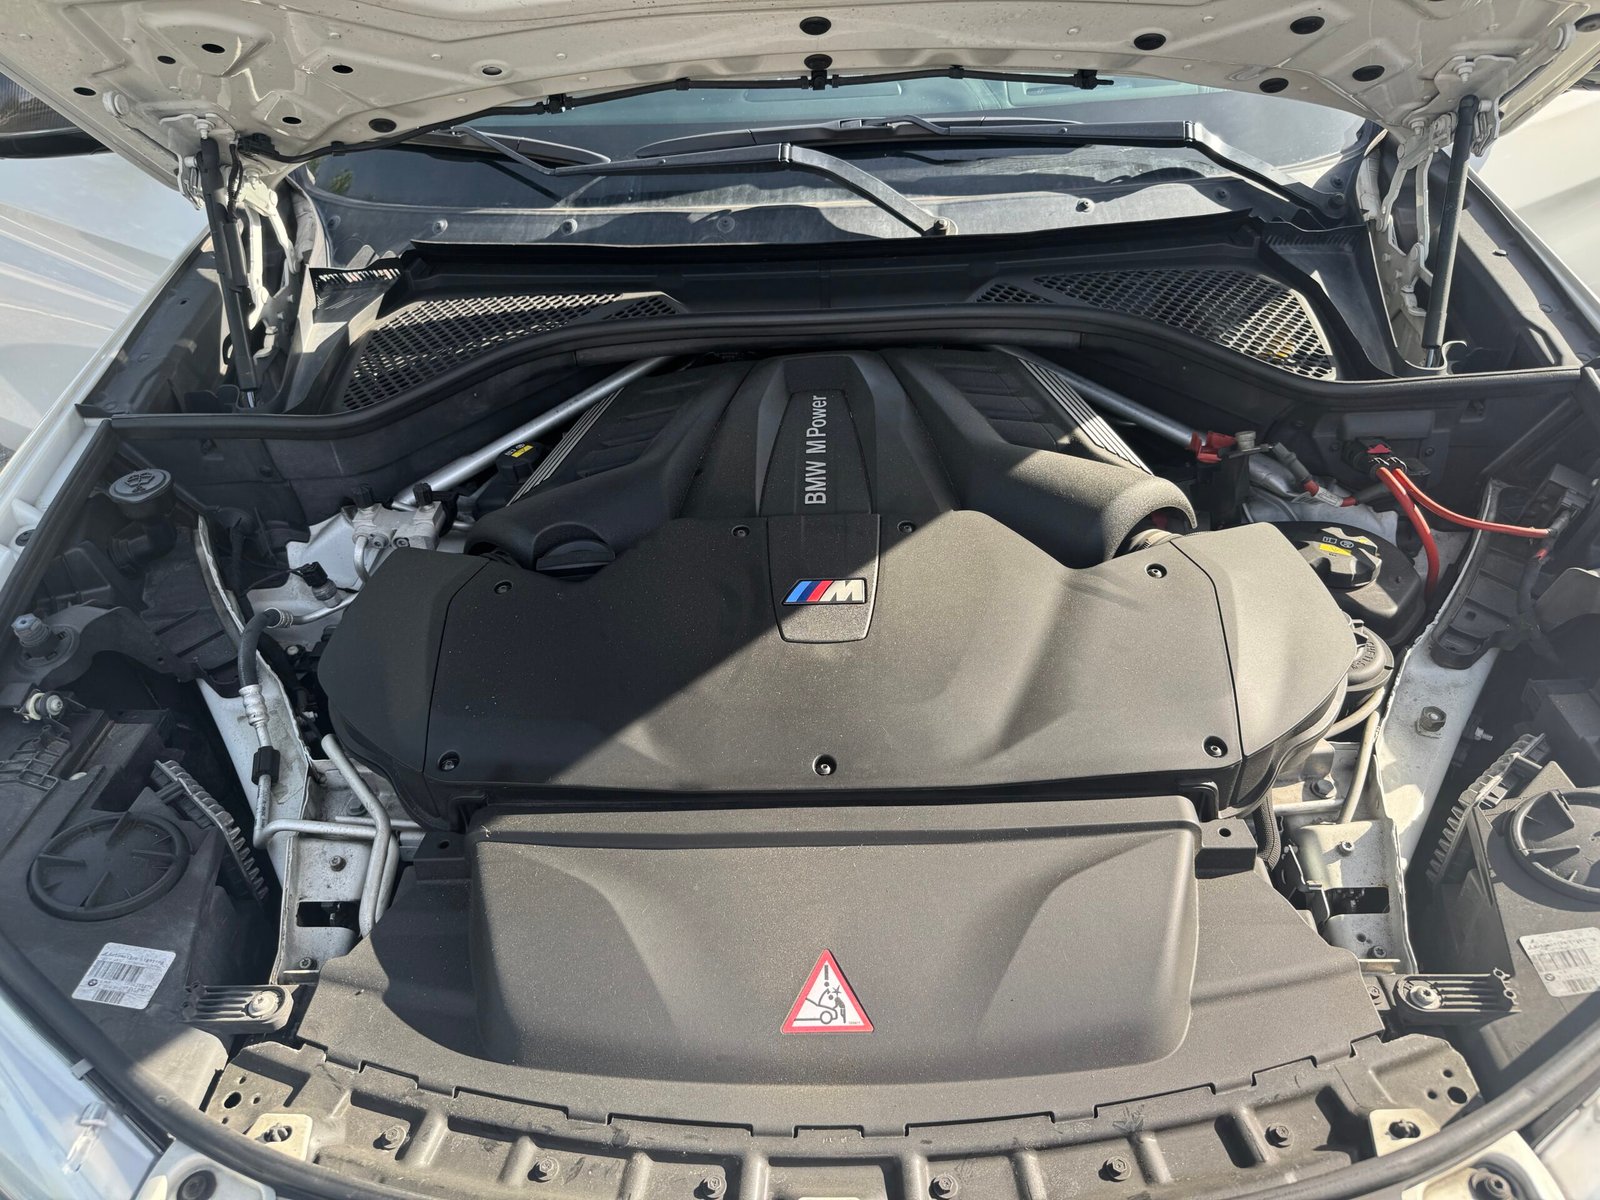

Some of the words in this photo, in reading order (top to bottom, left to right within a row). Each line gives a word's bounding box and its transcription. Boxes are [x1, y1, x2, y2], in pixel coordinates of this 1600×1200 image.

[806, 395, 827, 438] Power
[805, 440, 827, 454] M
[805, 461, 827, 505] BMW
[819, 579, 865, 603] M
